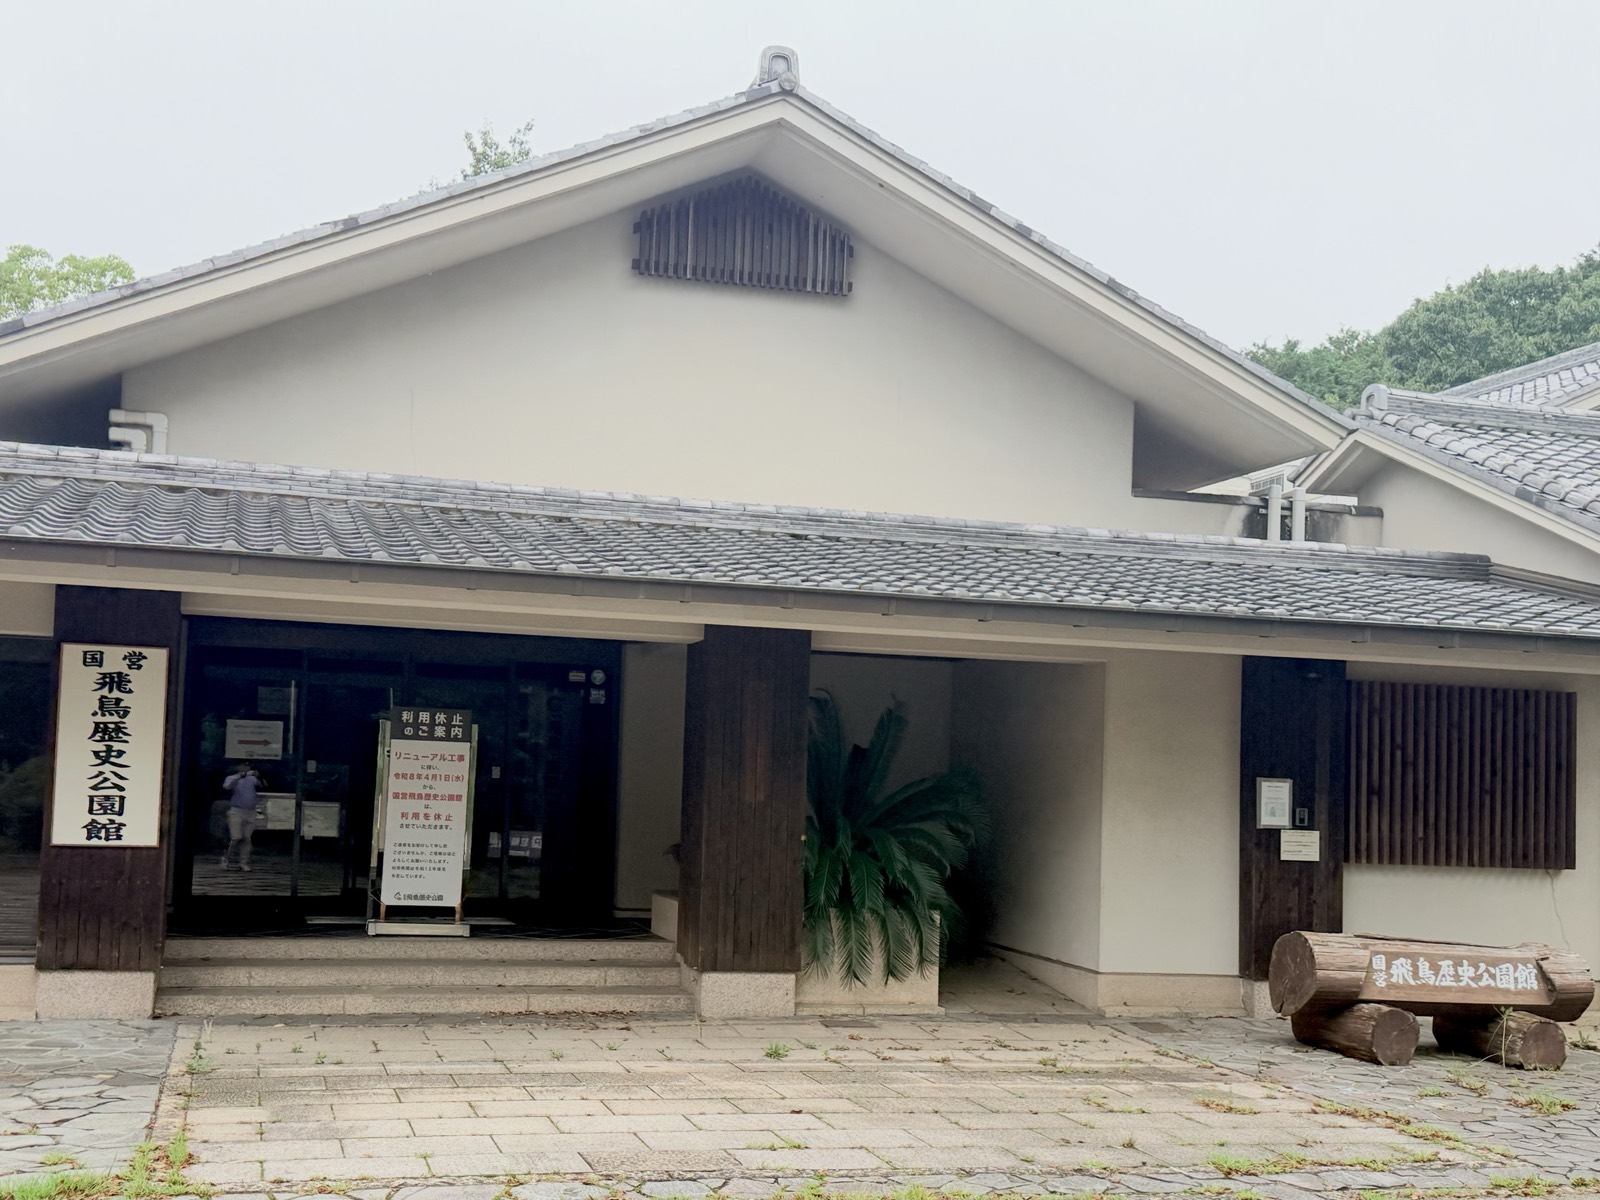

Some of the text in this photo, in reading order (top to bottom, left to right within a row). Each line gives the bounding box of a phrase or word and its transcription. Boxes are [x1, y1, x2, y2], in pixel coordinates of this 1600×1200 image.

[82, 650, 148, 671] 国営
[401, 710, 463, 725] 利用休止
[403, 725, 463, 738] のご案内
[81, 671, 134, 842] 飛鳥歴史公園館
[394, 751, 465, 762] リニューアル工事
[392, 791, 463, 803] 国営飛鳥歴史公園館
[400, 811, 453, 822] 利用を休止
[399, 823, 453, 831] させていただきます。
[1372, 954, 1387, 988] 国営
[1389, 956, 1538, 991] 飛鳥歴史公園館
